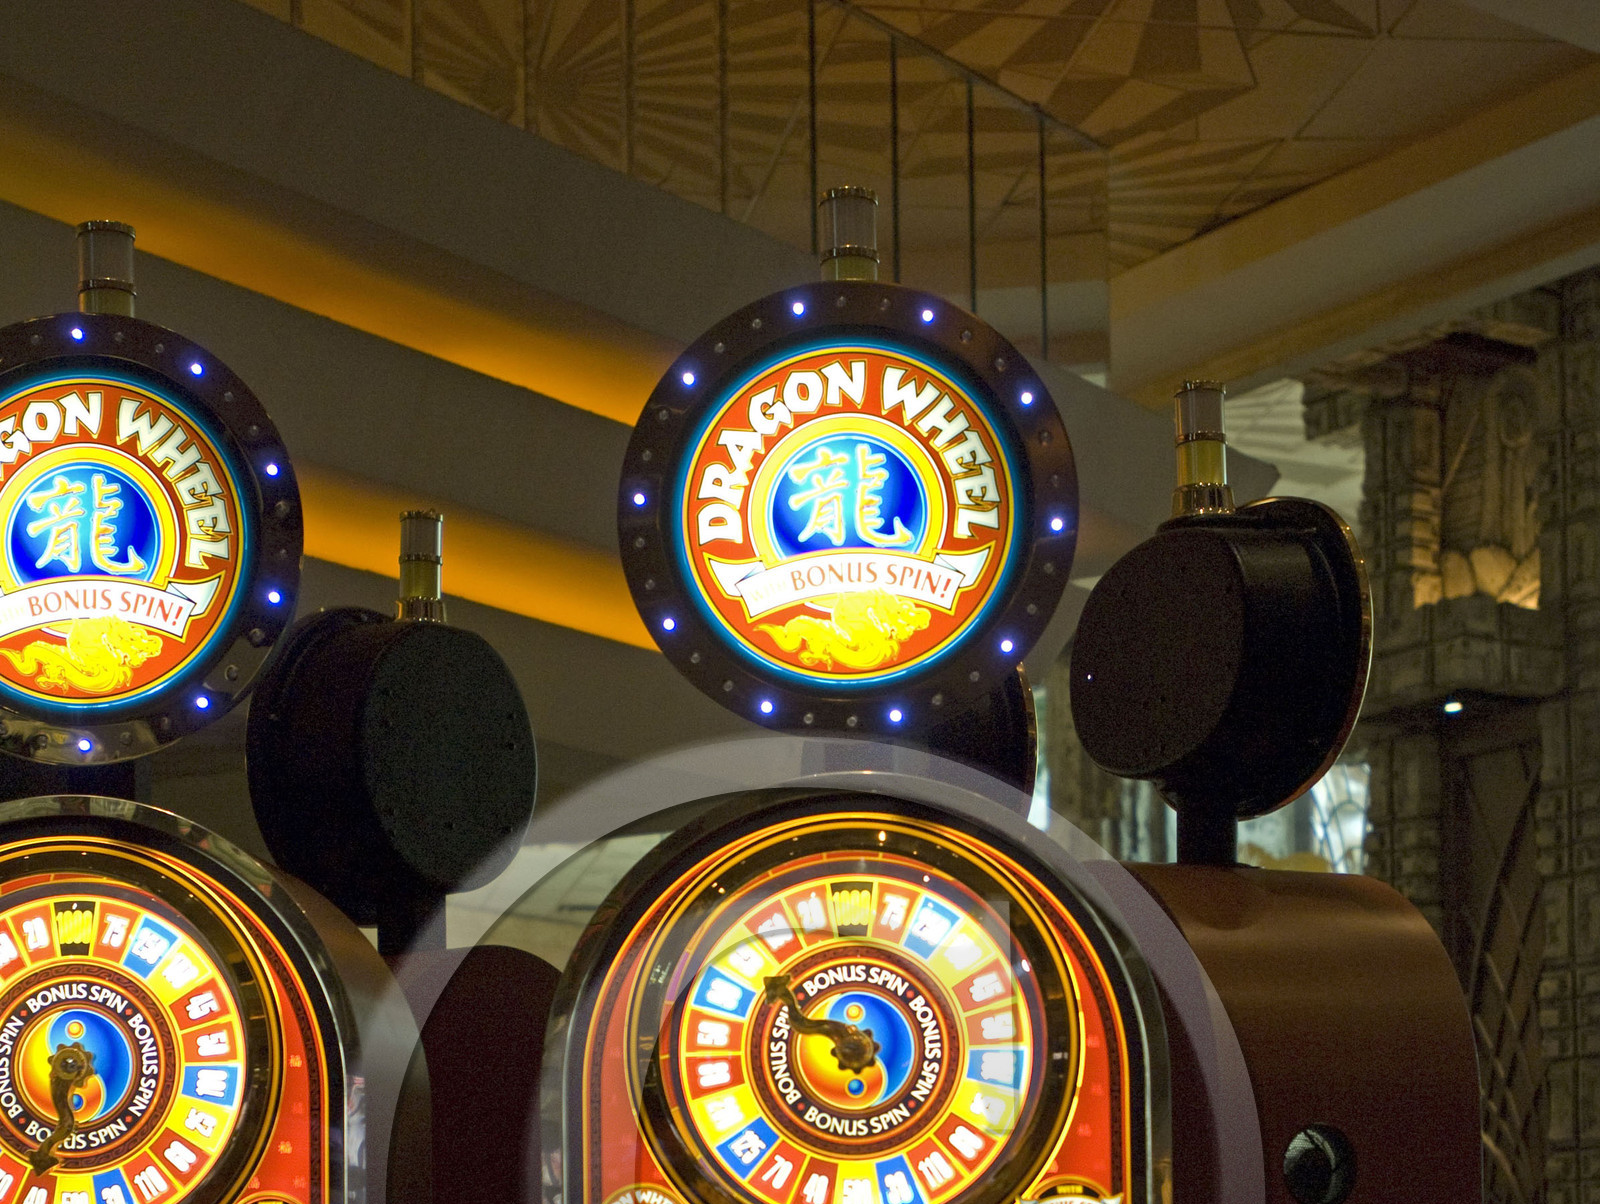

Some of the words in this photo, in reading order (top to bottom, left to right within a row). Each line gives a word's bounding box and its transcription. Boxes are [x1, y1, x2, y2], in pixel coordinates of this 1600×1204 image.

[697, 360, 867, 546] DRAGON
[880, 366, 1001, 539] WHEEL
[0, 391, 103, 481] GON
[116, 397, 233, 570] WHEEL
[788, 443, 914, 547] 龍
[26, 474, 147, 575] 龍
[791, 562, 878, 591] BONUS
[886, 562, 951, 599] SPIN!
[28, 588, 112, 617] BONUS
[120, 591, 184, 627] SPIN!
[56, 910, 94, 944] 1000
[880, 893, 909, 930] 75
[22, 916, 50, 950] 20
[101, 914, 130, 948] 75
[25, 983, 88, 1014] BONUS
[88, 985, 129, 1014] SPIN
[801, 964, 868, 997] BONUS
[868, 967, 910, 997] SPIN
[186, 991, 220, 1020] 45
[770, 1004, 793, 1040] SPI
[0, 1015, 25, 1051] SPIN
[127, 1013, 159, 1075] BONUS
[197, 1029, 230, 1057] 50
[908, 995, 941, 1060] BONUS
[769, 1040, 801, 1105] BONUS
[910, 1061, 941, 1103] SPIN
[127, 1076, 157, 1117] SPIN
[24, 1120, 88, 1150] BOUS
[89, 1120, 129, 1148] SPIN
[803, 1105, 868, 1136] BONUS
[870, 1104, 911, 1133] SPIN
[727, 1128, 768, 1167] 125
[134, 1165, 169, 1201] 110
[760, 1154, 794, 1190] 70
[917, 1150, 955, 1189] 110
